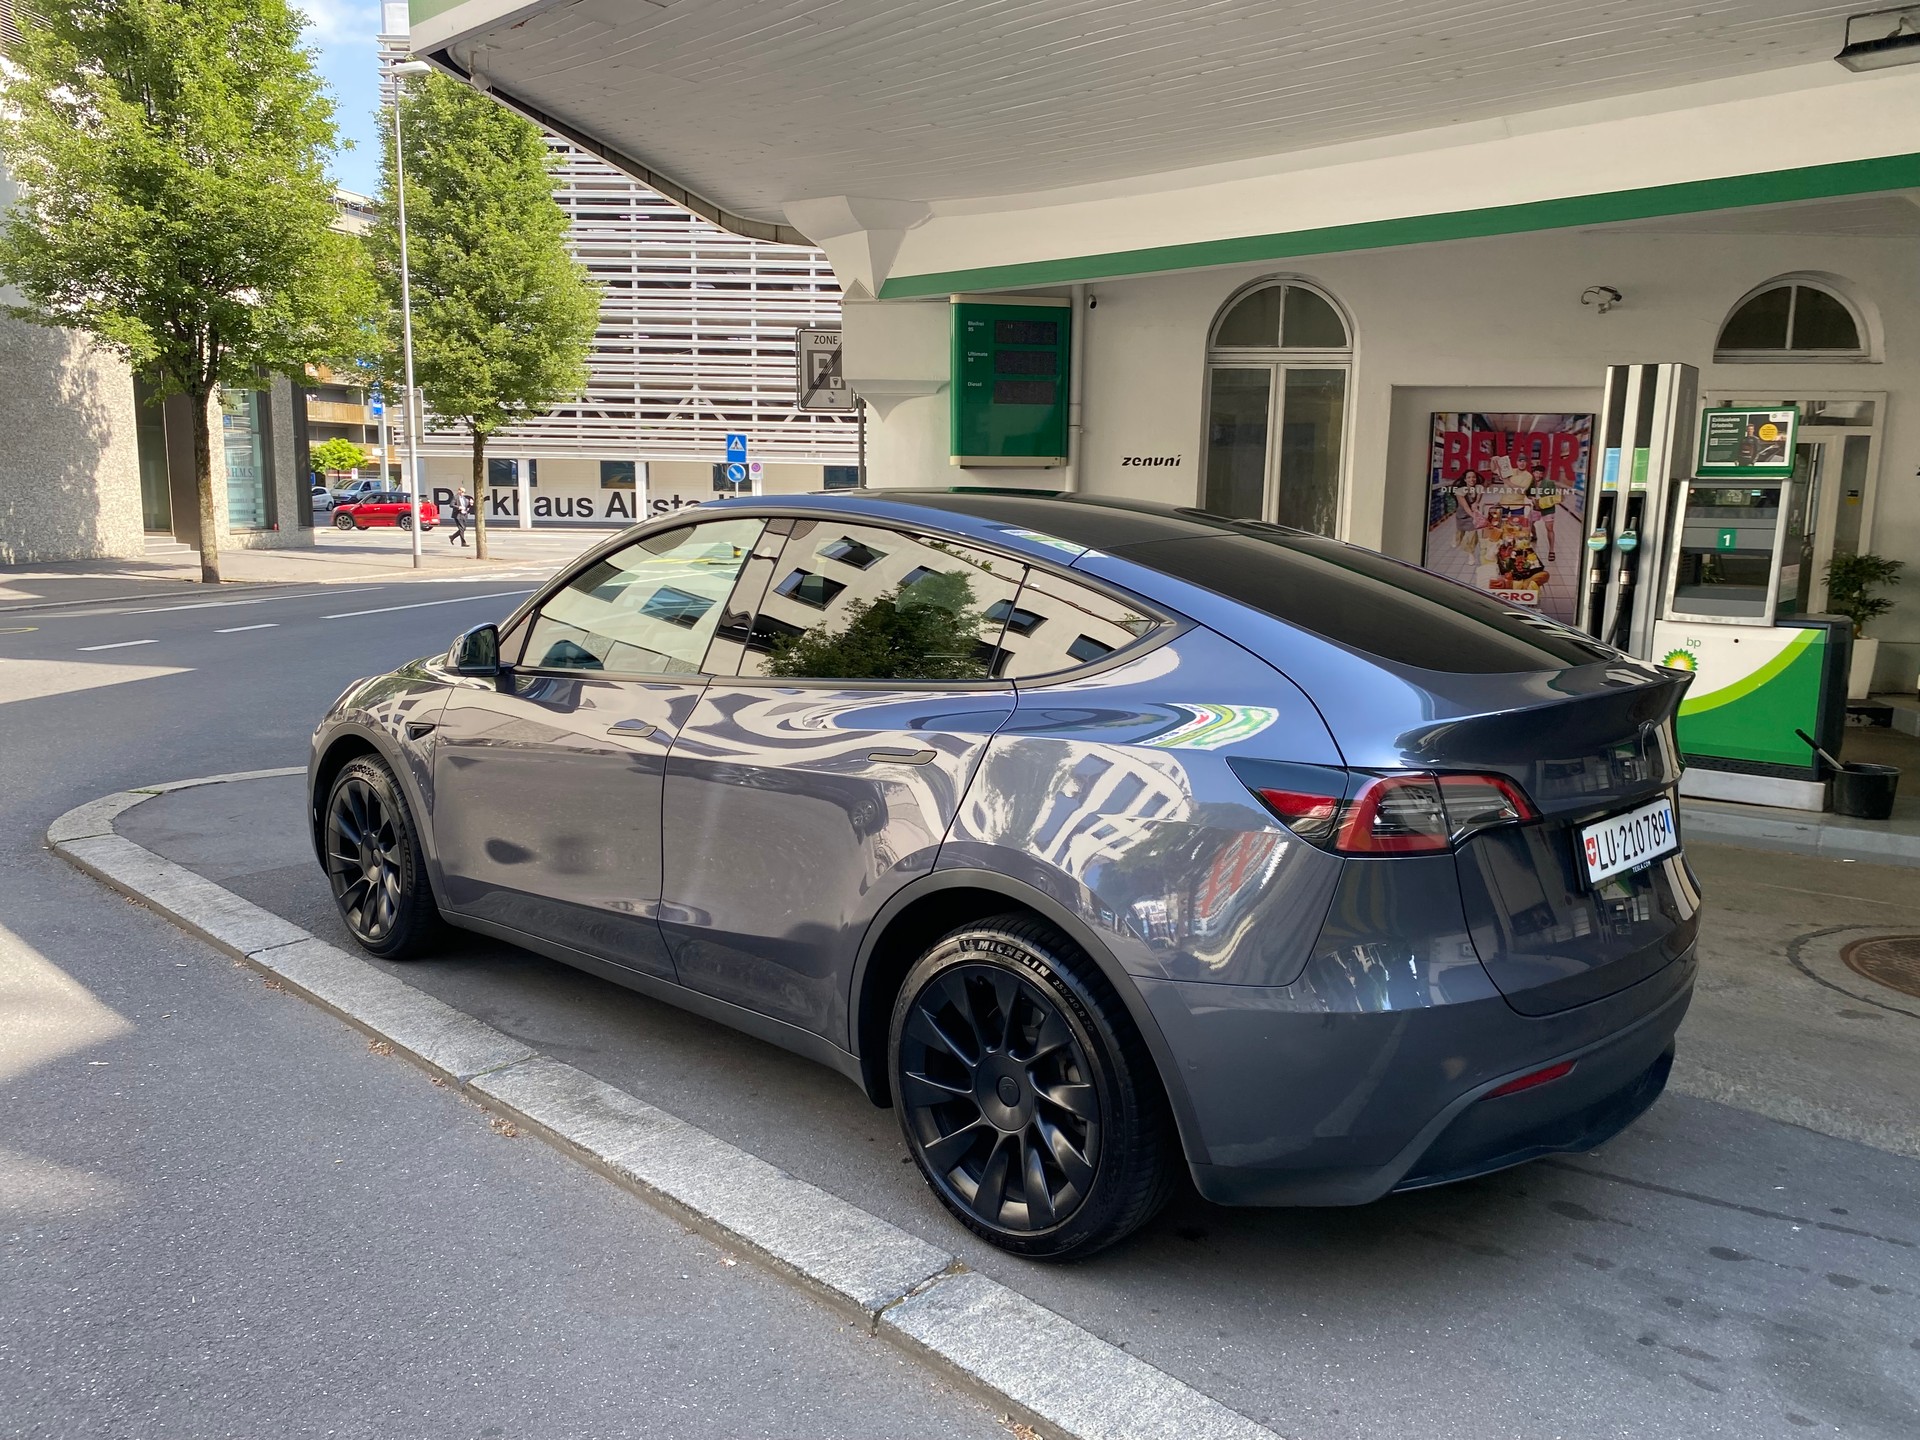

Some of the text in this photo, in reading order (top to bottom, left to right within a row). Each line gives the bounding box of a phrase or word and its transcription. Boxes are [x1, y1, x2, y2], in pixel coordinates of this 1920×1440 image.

[813, 335, 838, 345] ZONE
[1441, 431, 1580, 481] BEVOR
[1441, 486, 1458, 494] DIE
[1463, 487, 1527, 495] GRILLPARTY
[604, 491, 736, 519] Alst
[1723, 534, 1731, 547] 1
[1686, 637, 1702, 649] bp
[978, 940, 1051, 977] MICHELIN
